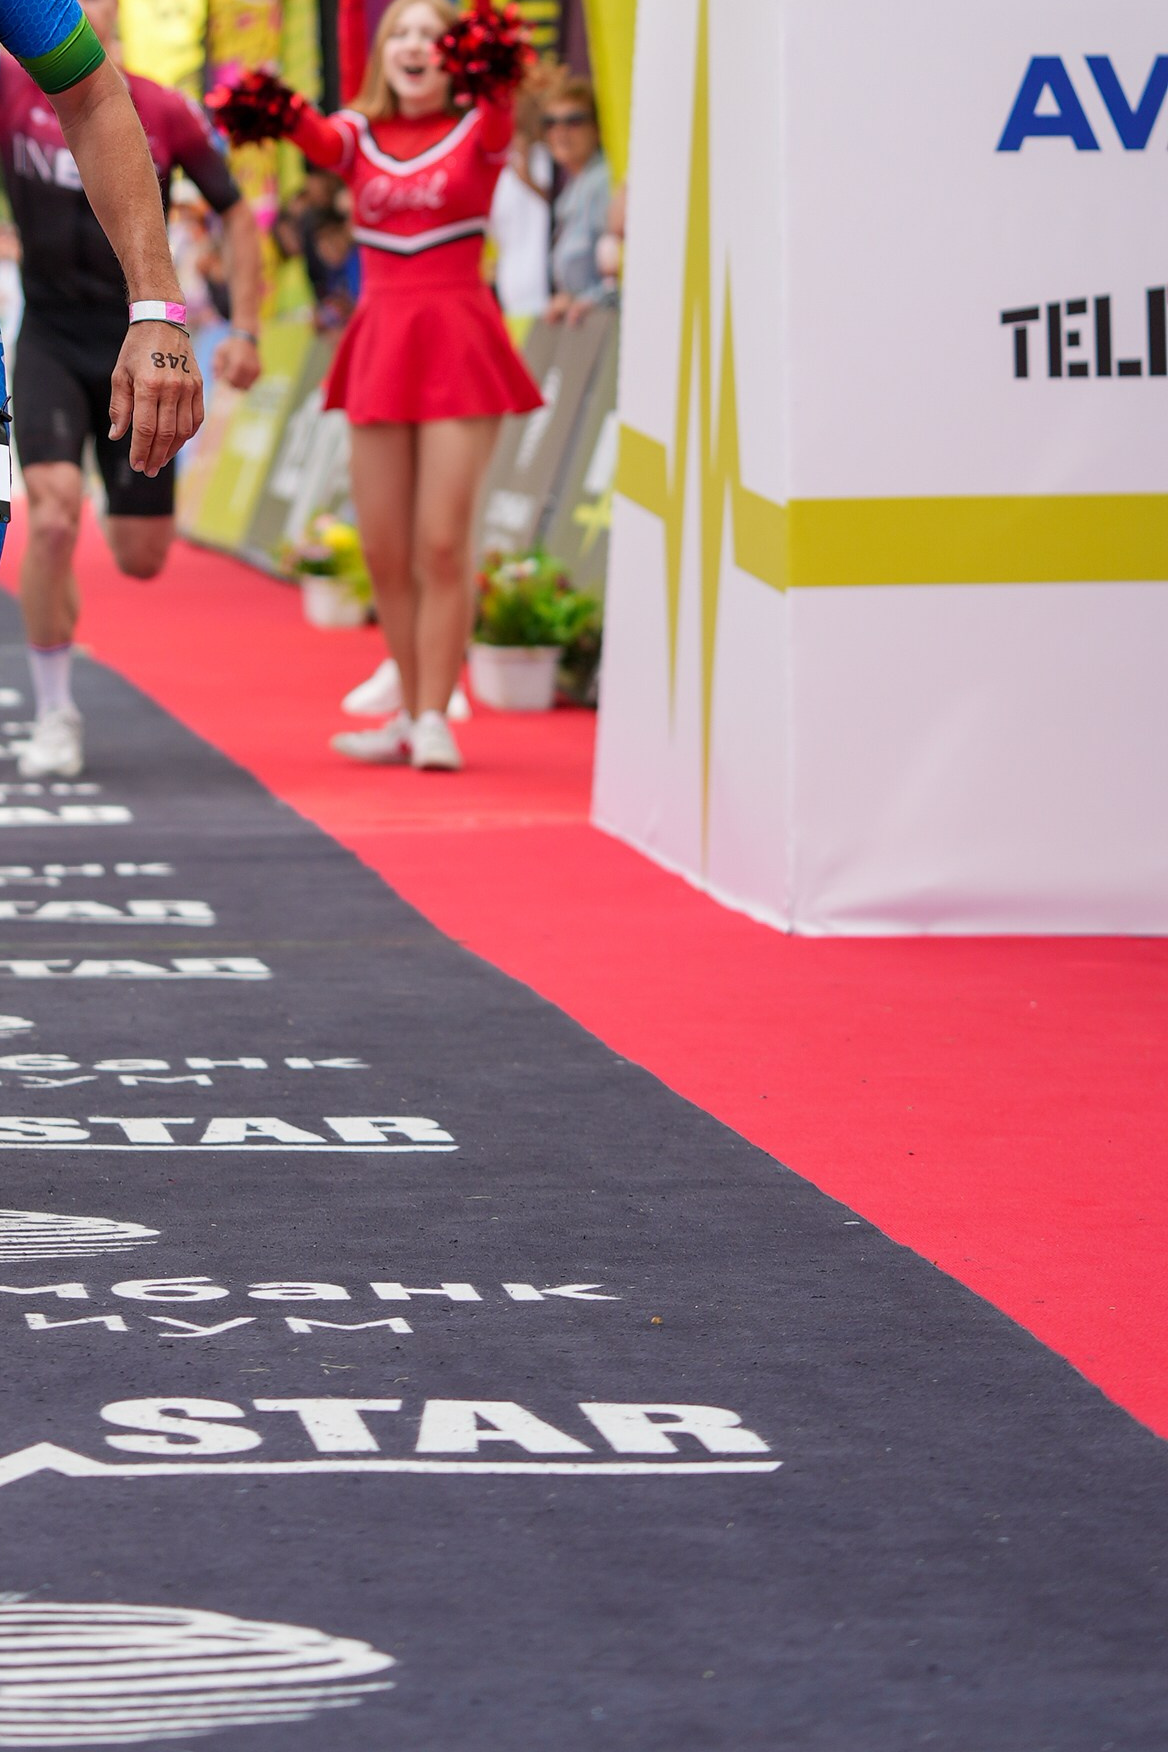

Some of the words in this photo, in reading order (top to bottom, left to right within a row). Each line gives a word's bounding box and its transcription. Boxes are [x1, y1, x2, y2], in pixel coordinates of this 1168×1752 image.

[994, 54, 1168, 153] AV
[150, 351, 190, 374] 248
[98, 1395, 775, 1460] STAR
